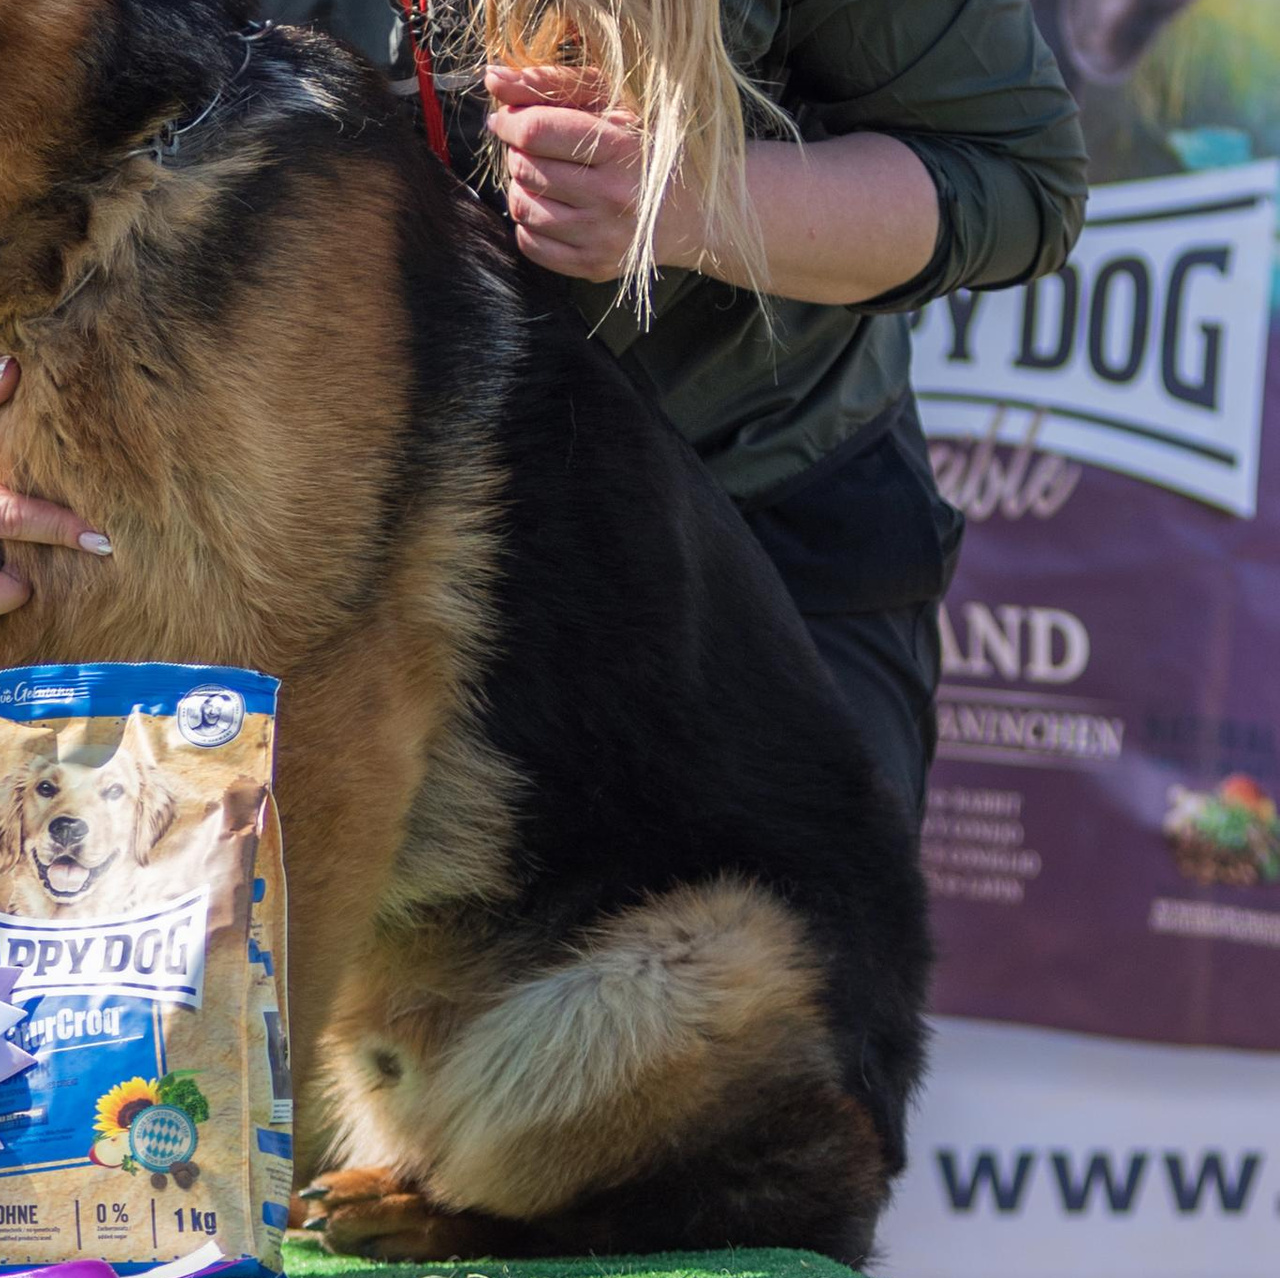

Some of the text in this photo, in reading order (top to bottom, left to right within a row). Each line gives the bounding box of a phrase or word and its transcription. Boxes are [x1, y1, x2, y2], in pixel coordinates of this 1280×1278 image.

[1013, 244, 1234, 412] DOG
[100, 915, 193, 976] DOG
[96, 1202, 129, 1223] 0 %
[174, 1207, 218, 1236] 1 kg
